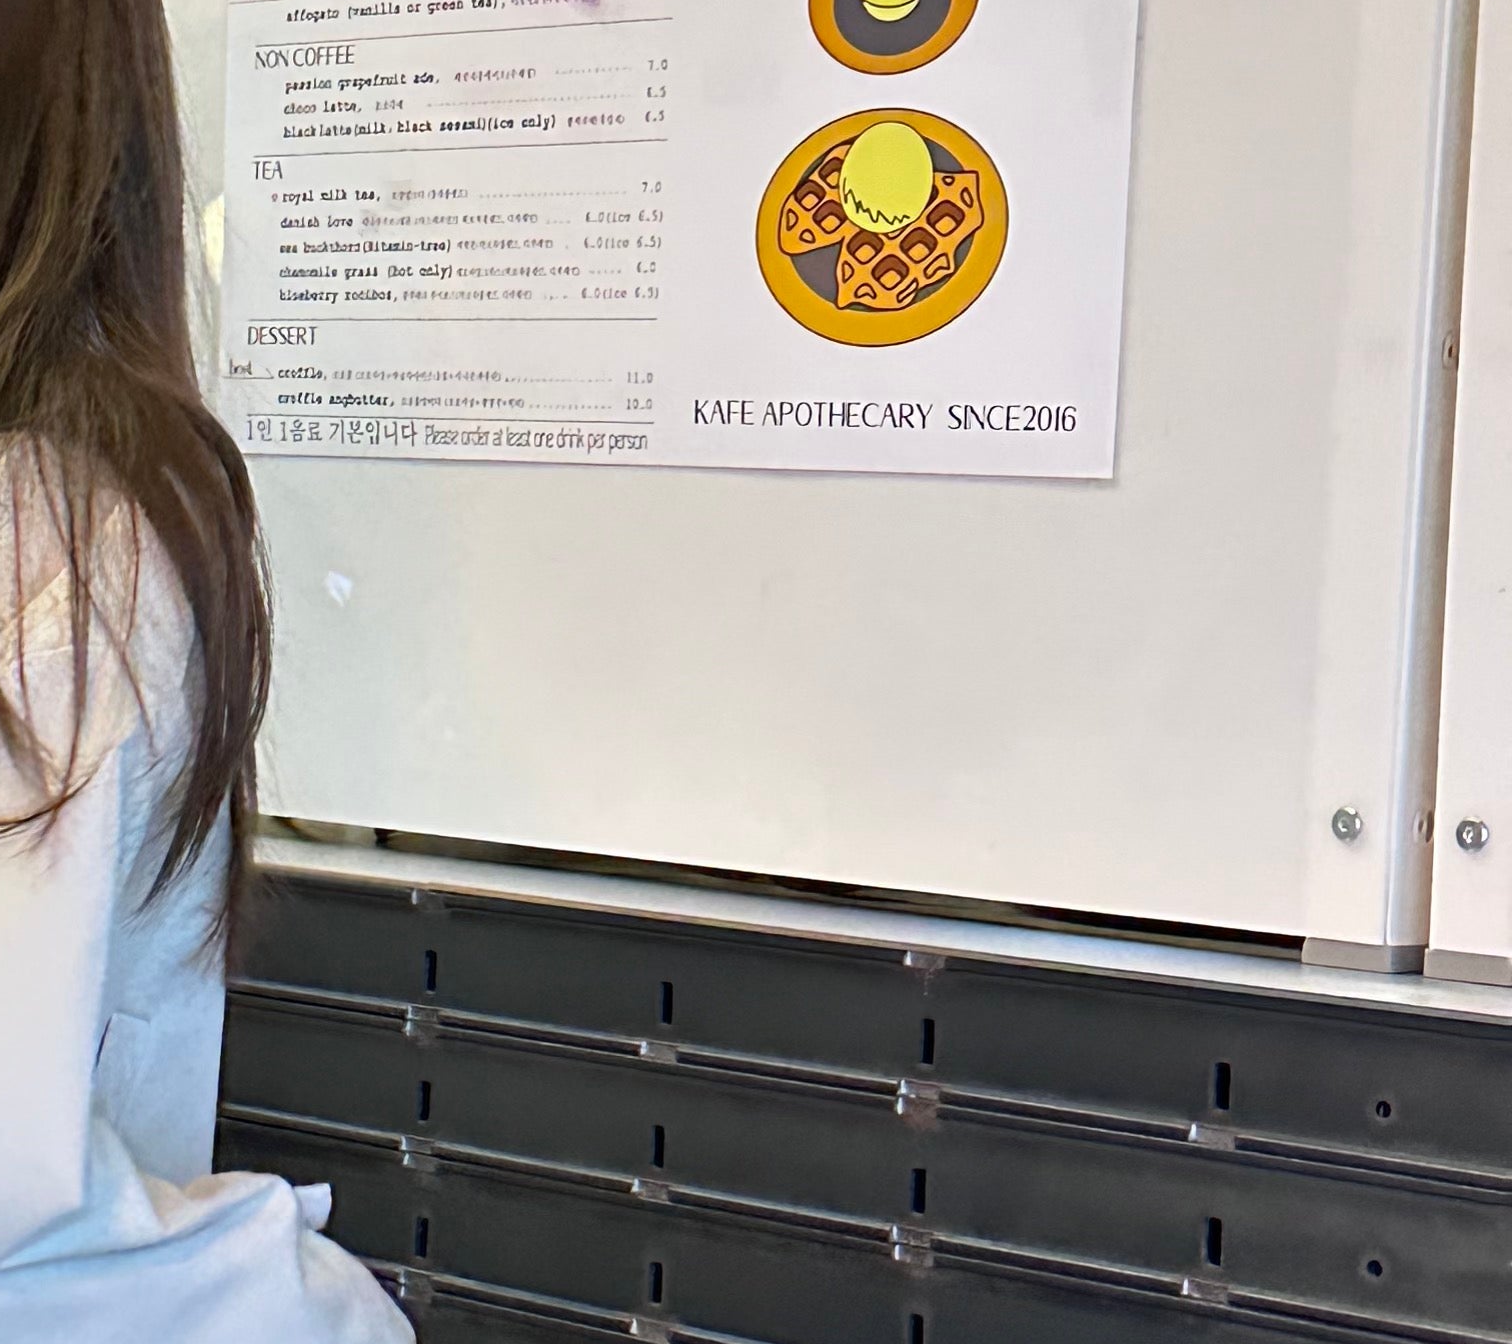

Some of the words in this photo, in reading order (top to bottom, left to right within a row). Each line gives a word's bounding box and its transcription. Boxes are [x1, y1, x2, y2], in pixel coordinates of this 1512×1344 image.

[255, 50, 289, 69] NON
[293, 45, 356, 67] COFFEE
[252, 160, 283, 180] TEA
[248, 326, 317, 345] DESSERT
[694, 399, 755, 426] KAFE
[762, 401, 933, 430] APOTHECARY
